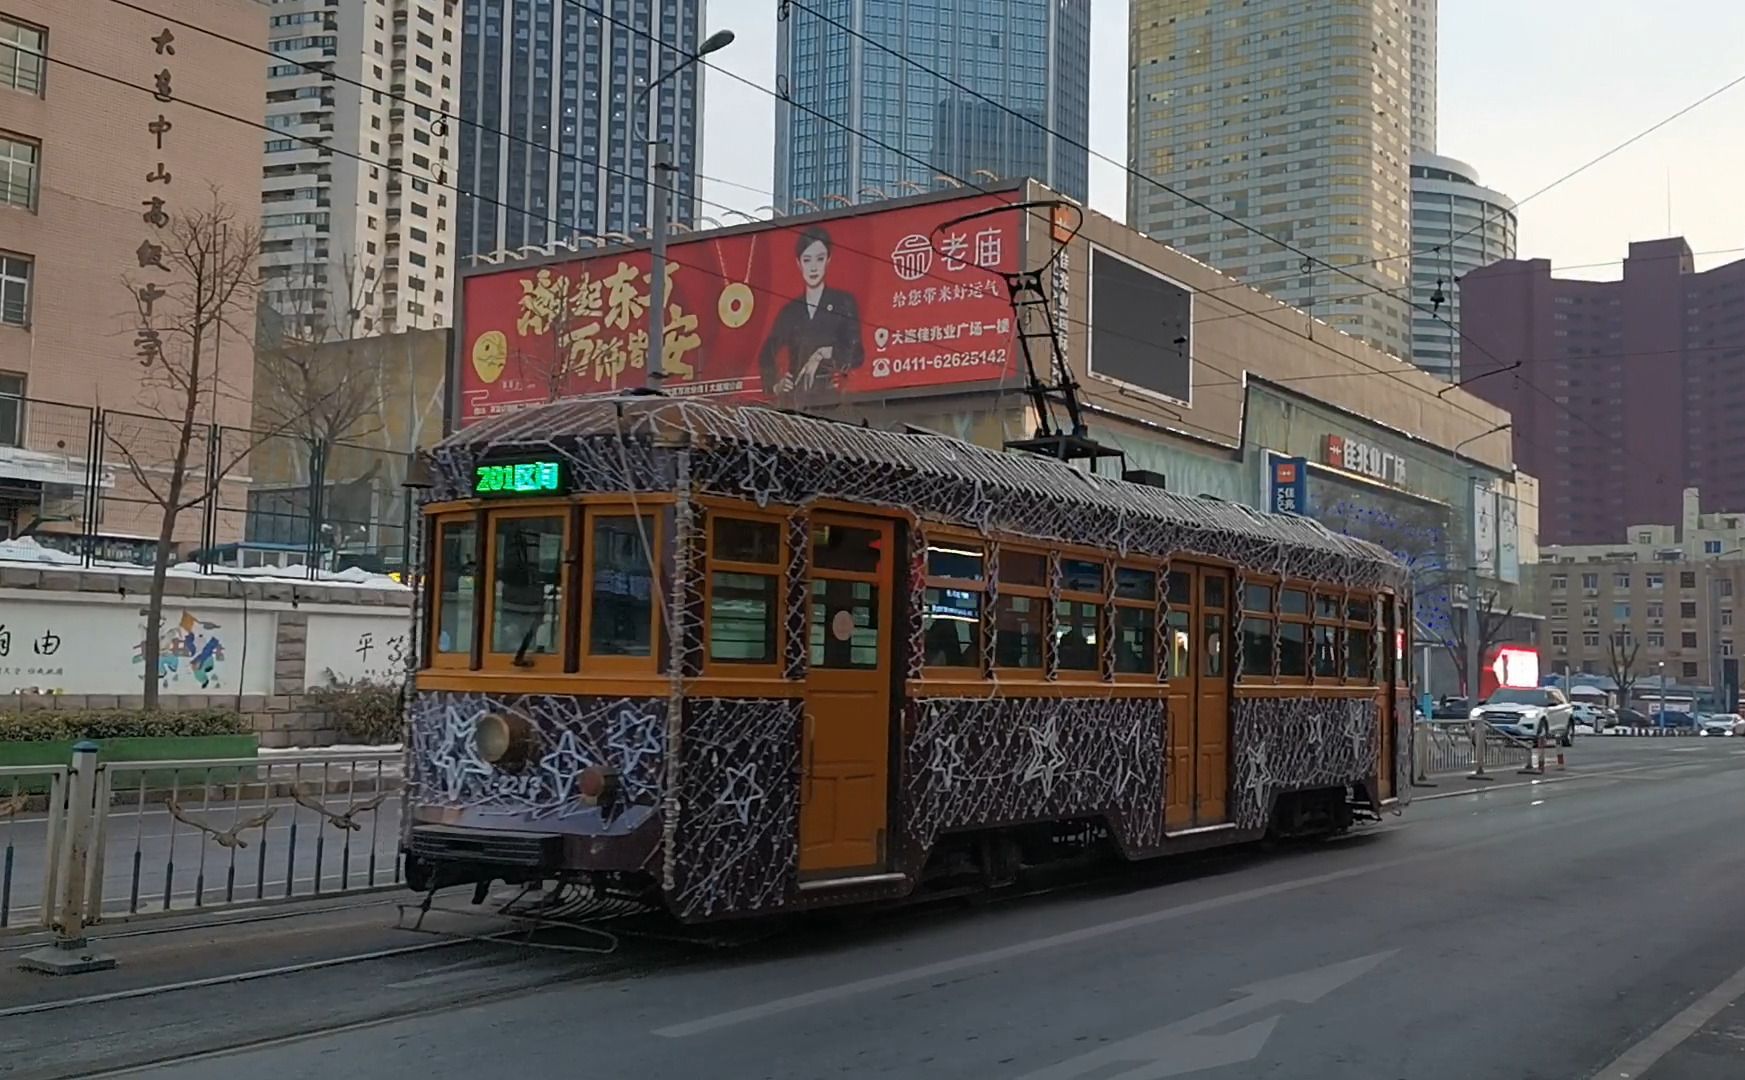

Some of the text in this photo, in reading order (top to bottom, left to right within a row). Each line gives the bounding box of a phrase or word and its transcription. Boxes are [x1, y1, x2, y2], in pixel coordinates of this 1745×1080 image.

[941, 228, 1002, 271] 老庙
[893, 280, 999, 308] 给您带来好运气
[893, 349, 1006, 373] 0411-62625142
[1343, 438, 1407, 484] 佳兆业广场
